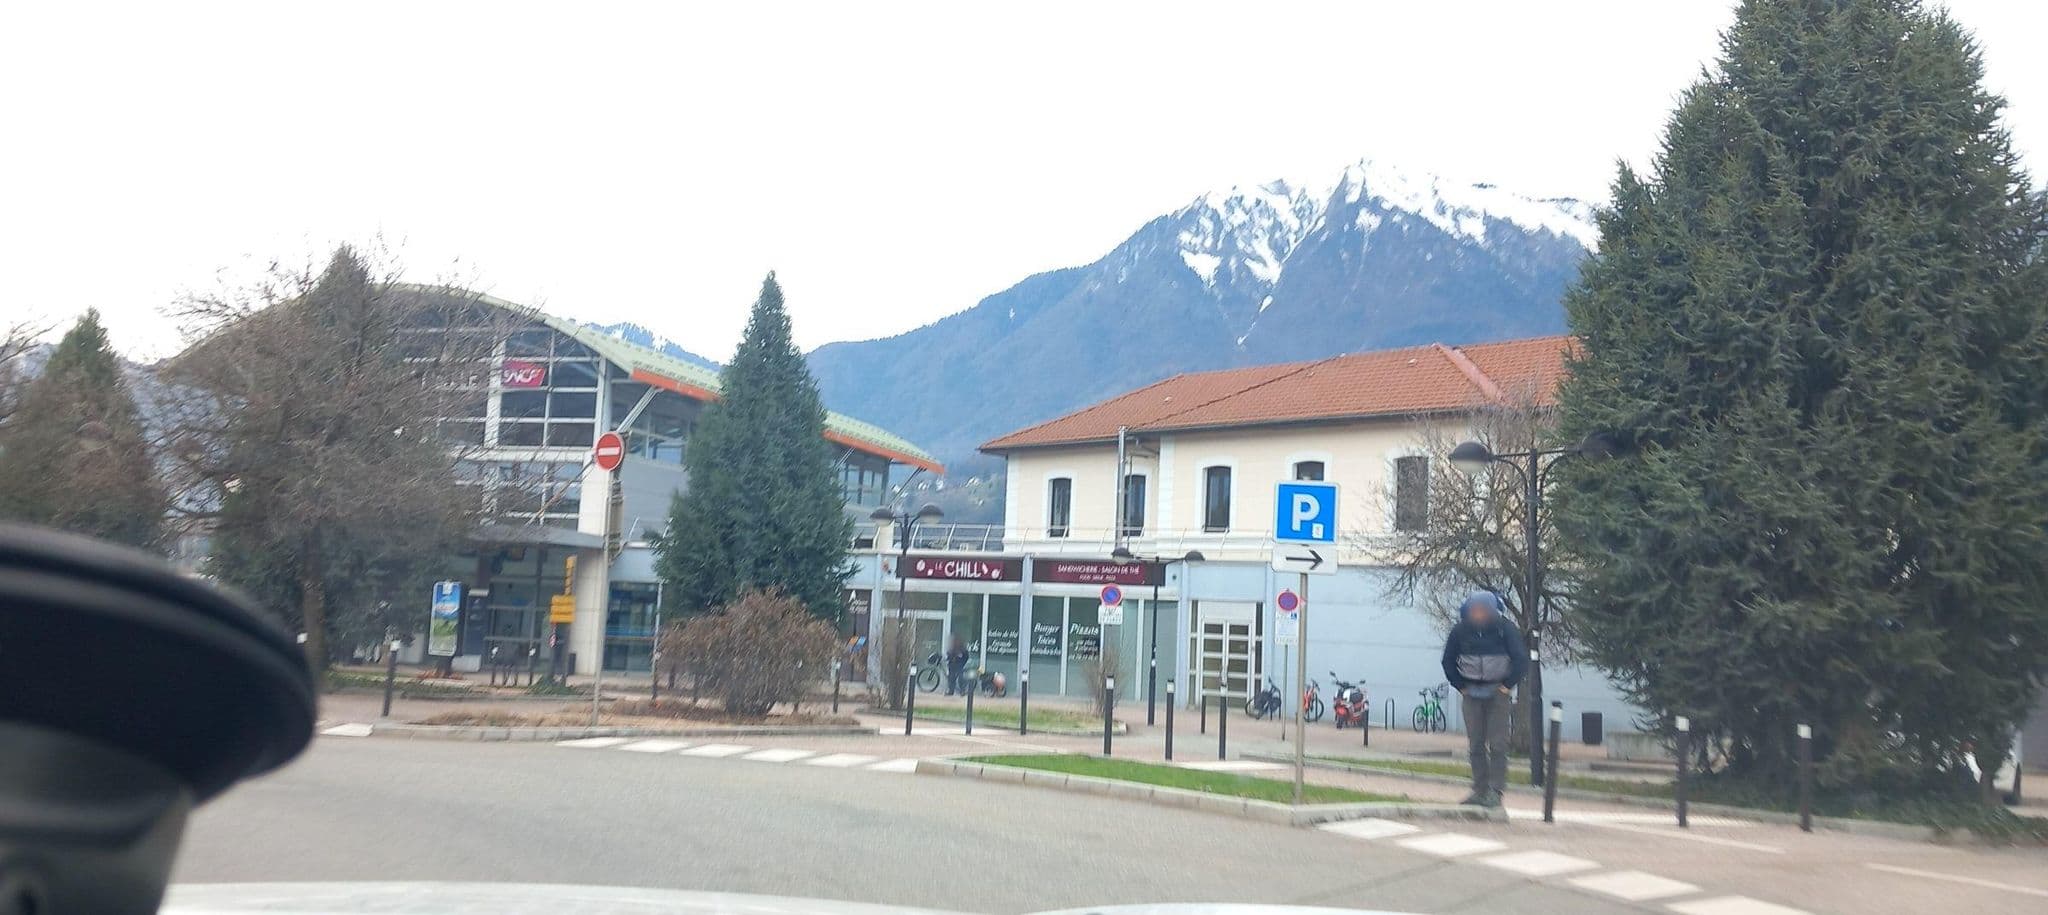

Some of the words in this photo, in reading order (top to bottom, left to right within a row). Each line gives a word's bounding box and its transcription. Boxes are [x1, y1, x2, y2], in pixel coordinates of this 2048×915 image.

[503, 368, 540, 384] SNCF
[1291, 493, 1320, 531] P
[944, 561, 981, 578] CHILL
[1034, 622, 1060, 636] Burger
